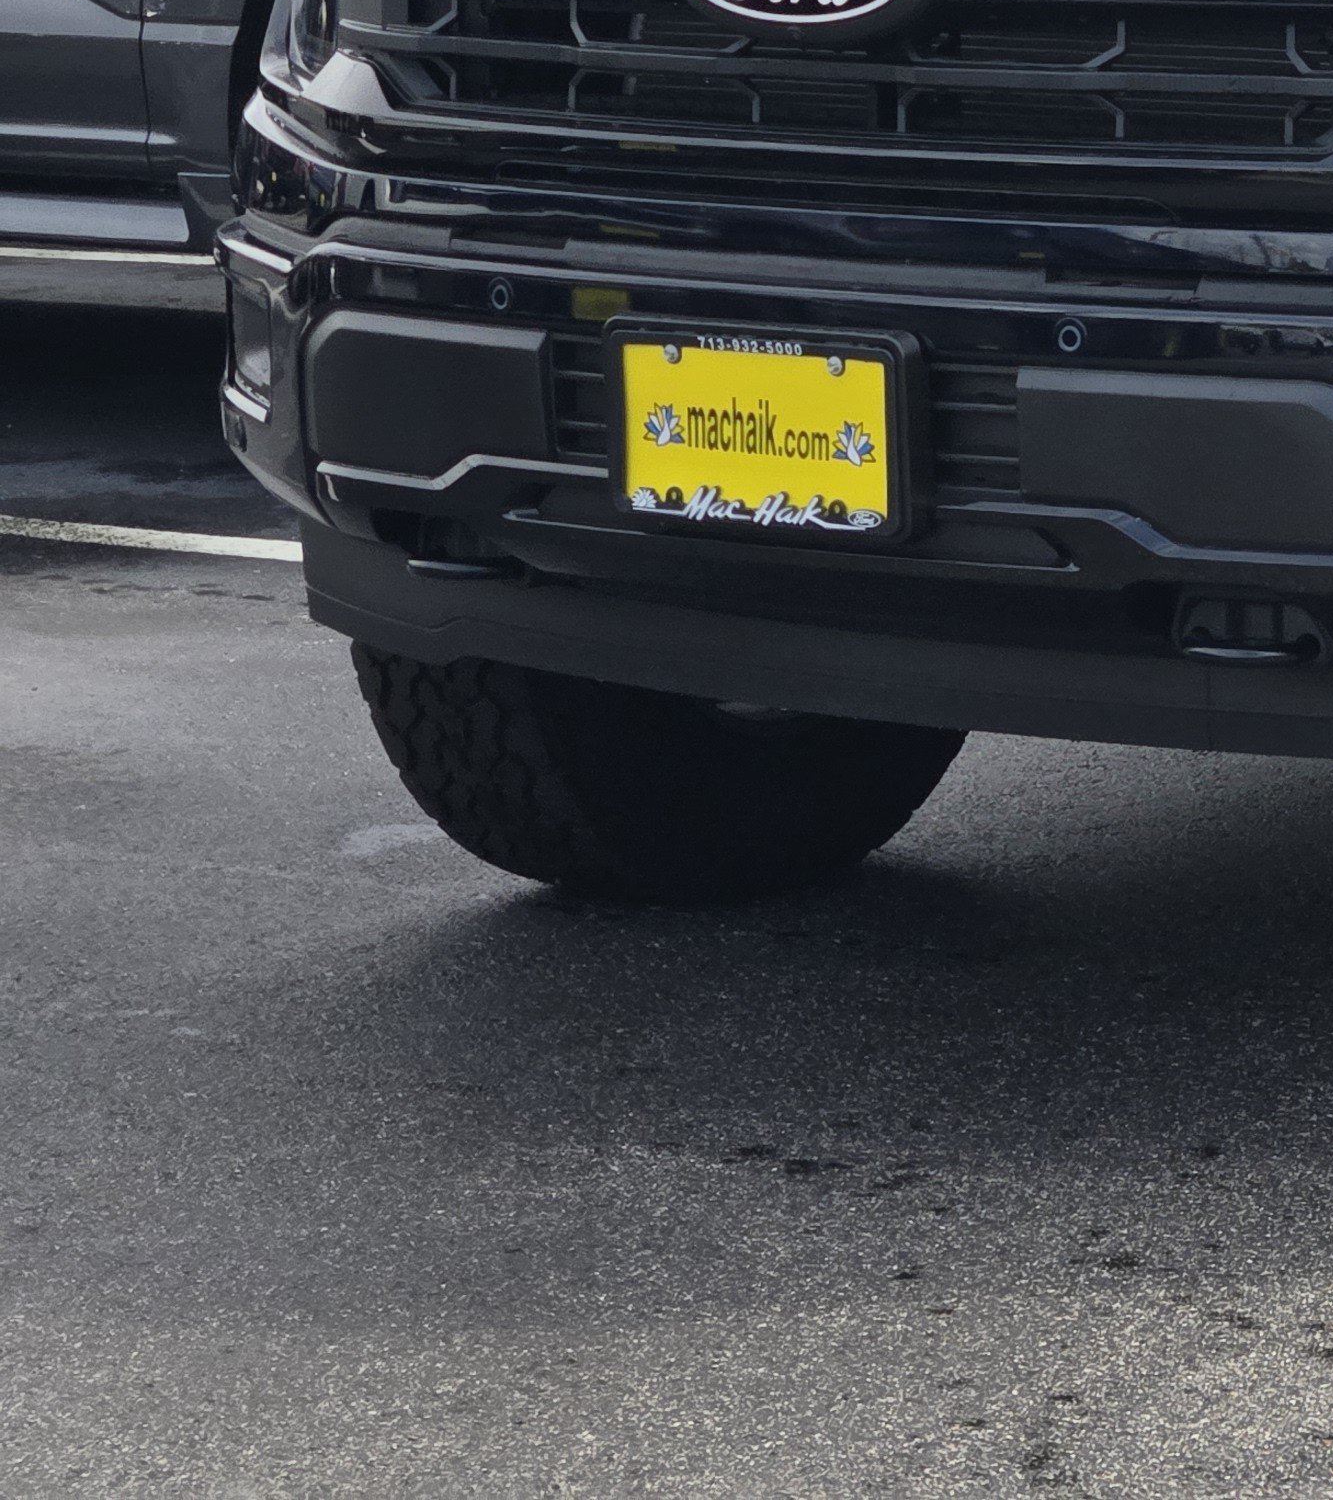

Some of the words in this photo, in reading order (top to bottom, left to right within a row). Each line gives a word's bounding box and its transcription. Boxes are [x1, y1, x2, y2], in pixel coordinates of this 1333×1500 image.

[696, 335, 803, 356] 713-932-5000
[687, 396, 830, 462] machaik.com
[680, 485, 751, 521] Mac
[752, 491, 830, 528] Haik
